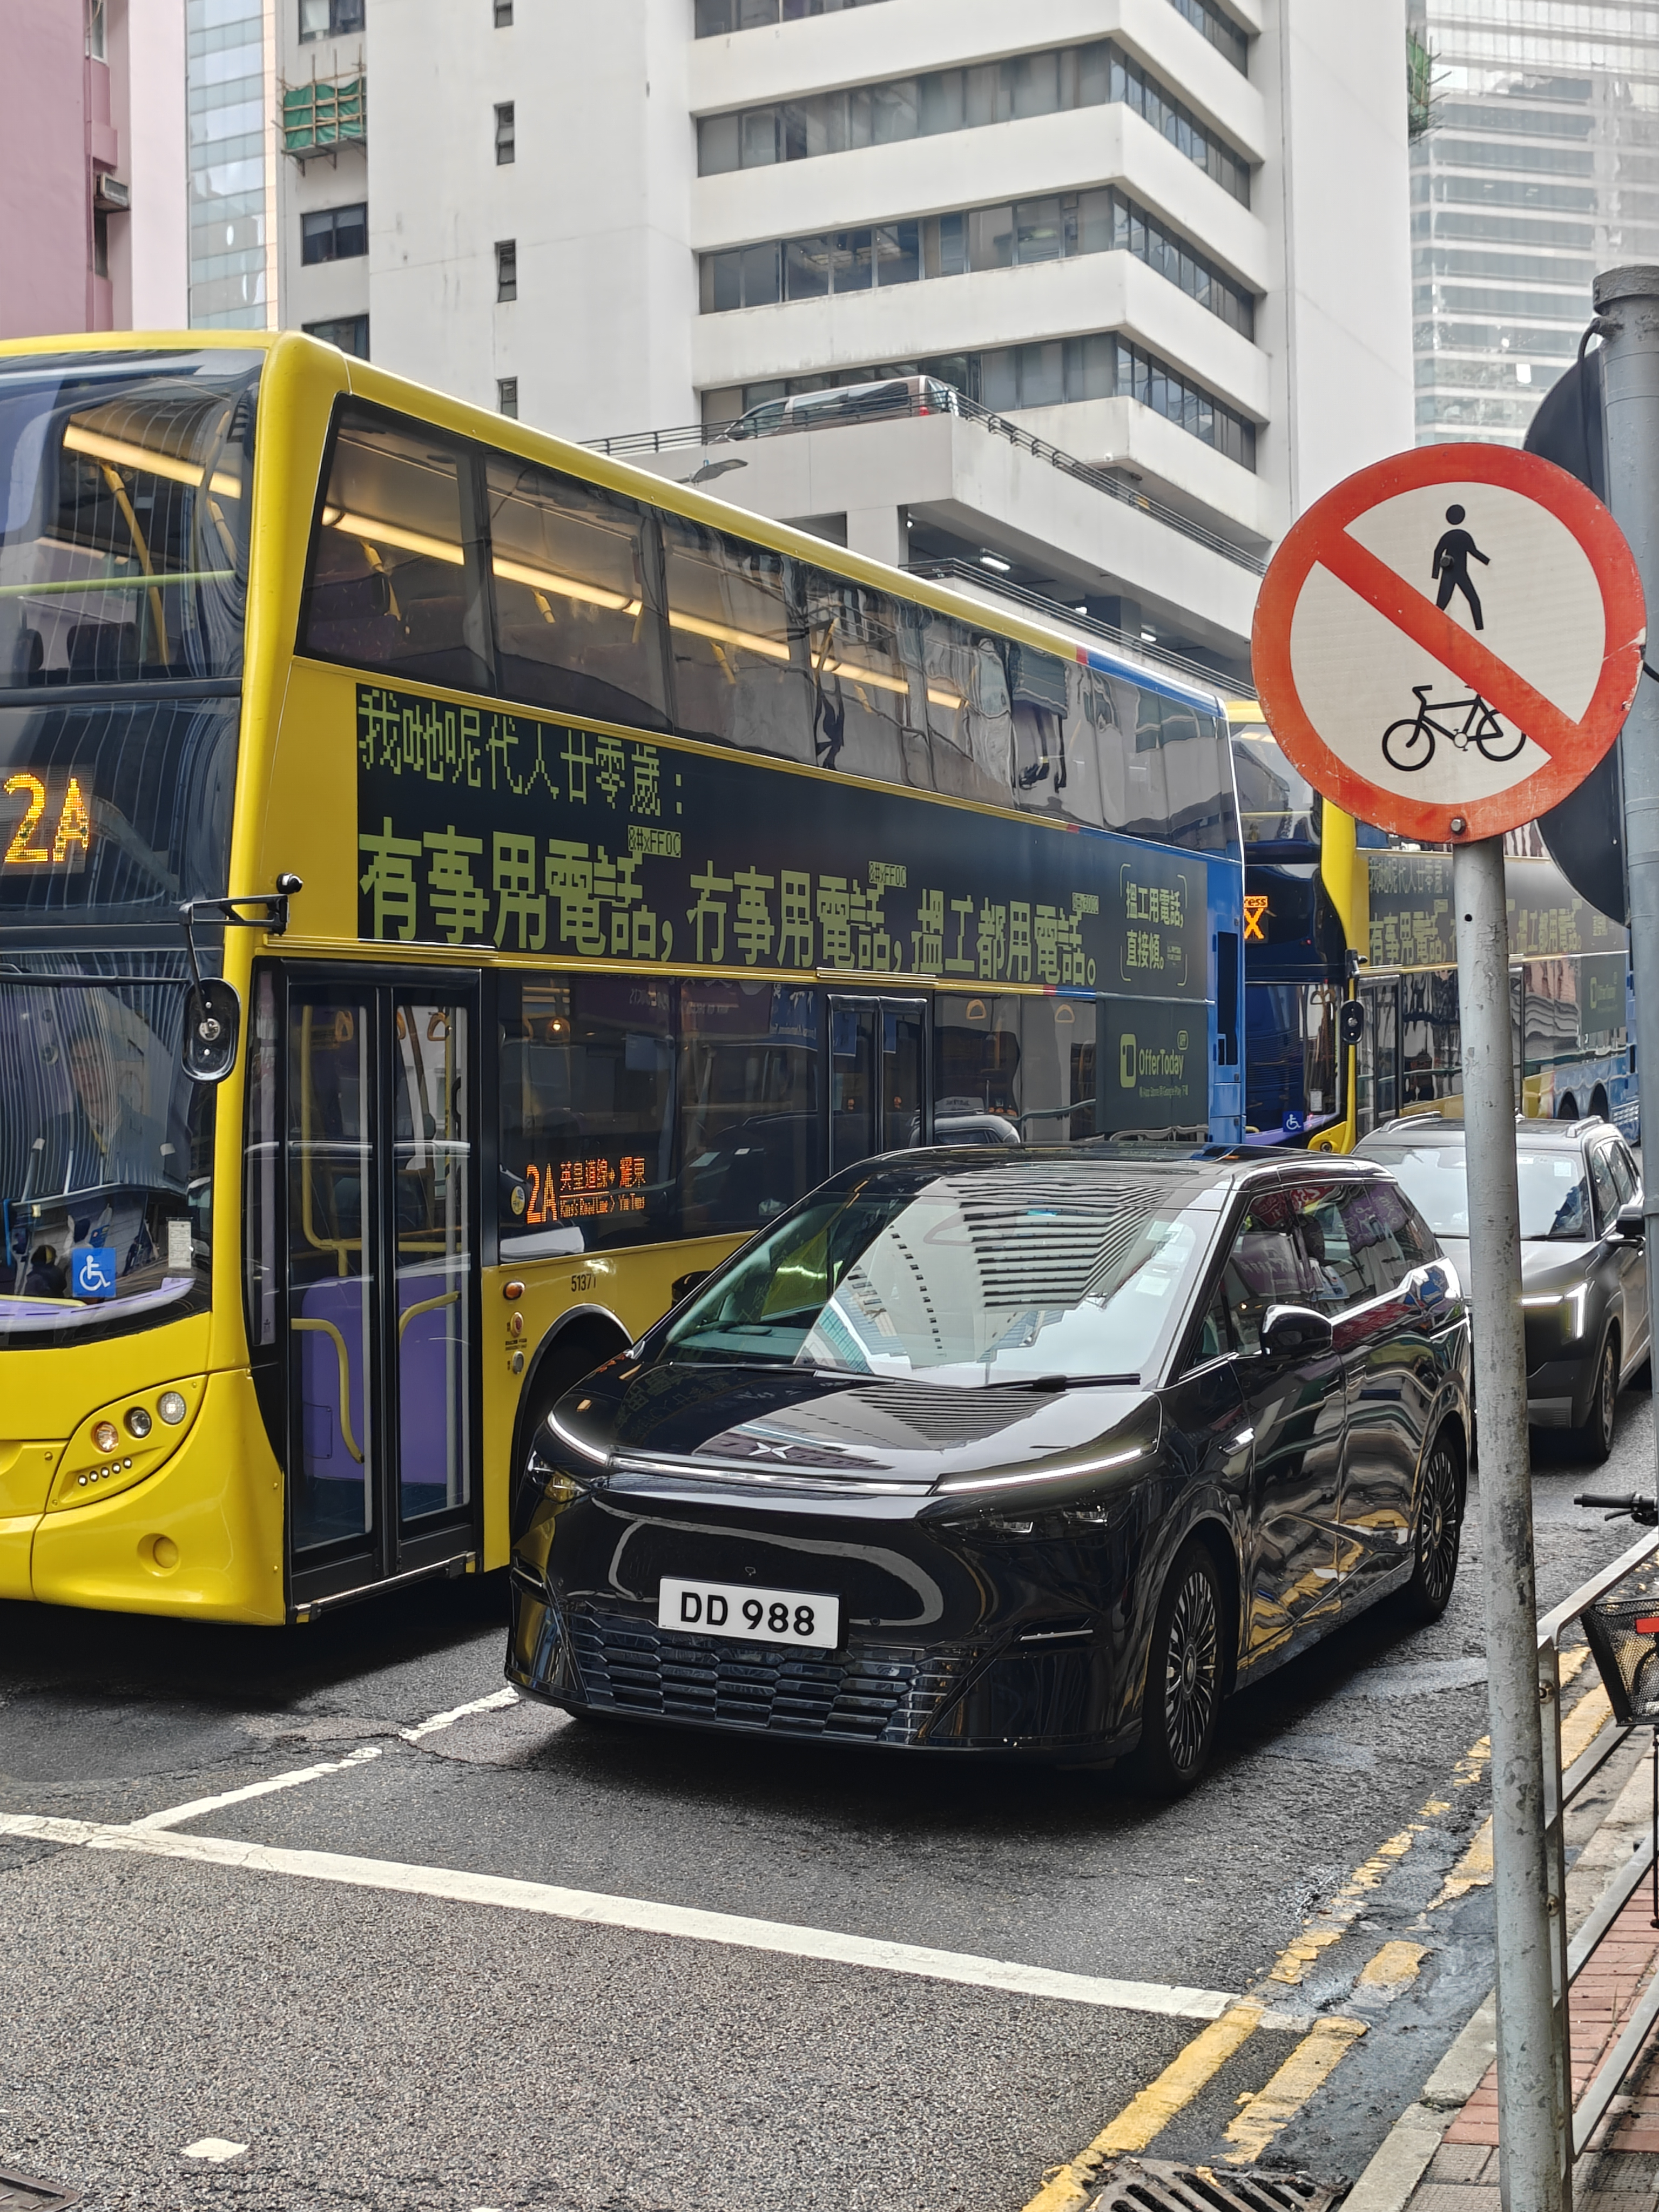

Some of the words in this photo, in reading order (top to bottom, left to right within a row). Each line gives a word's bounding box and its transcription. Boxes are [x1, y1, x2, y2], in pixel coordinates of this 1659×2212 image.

[4, 772, 89, 862] 2A
[1244, 908, 1265, 940] X
[1139, 1049, 1184, 1080] OfferToday
[526, 1163, 558, 1224] 2A
[681, 1591, 728, 1626] DD
[742, 1599, 814, 1636] 988
